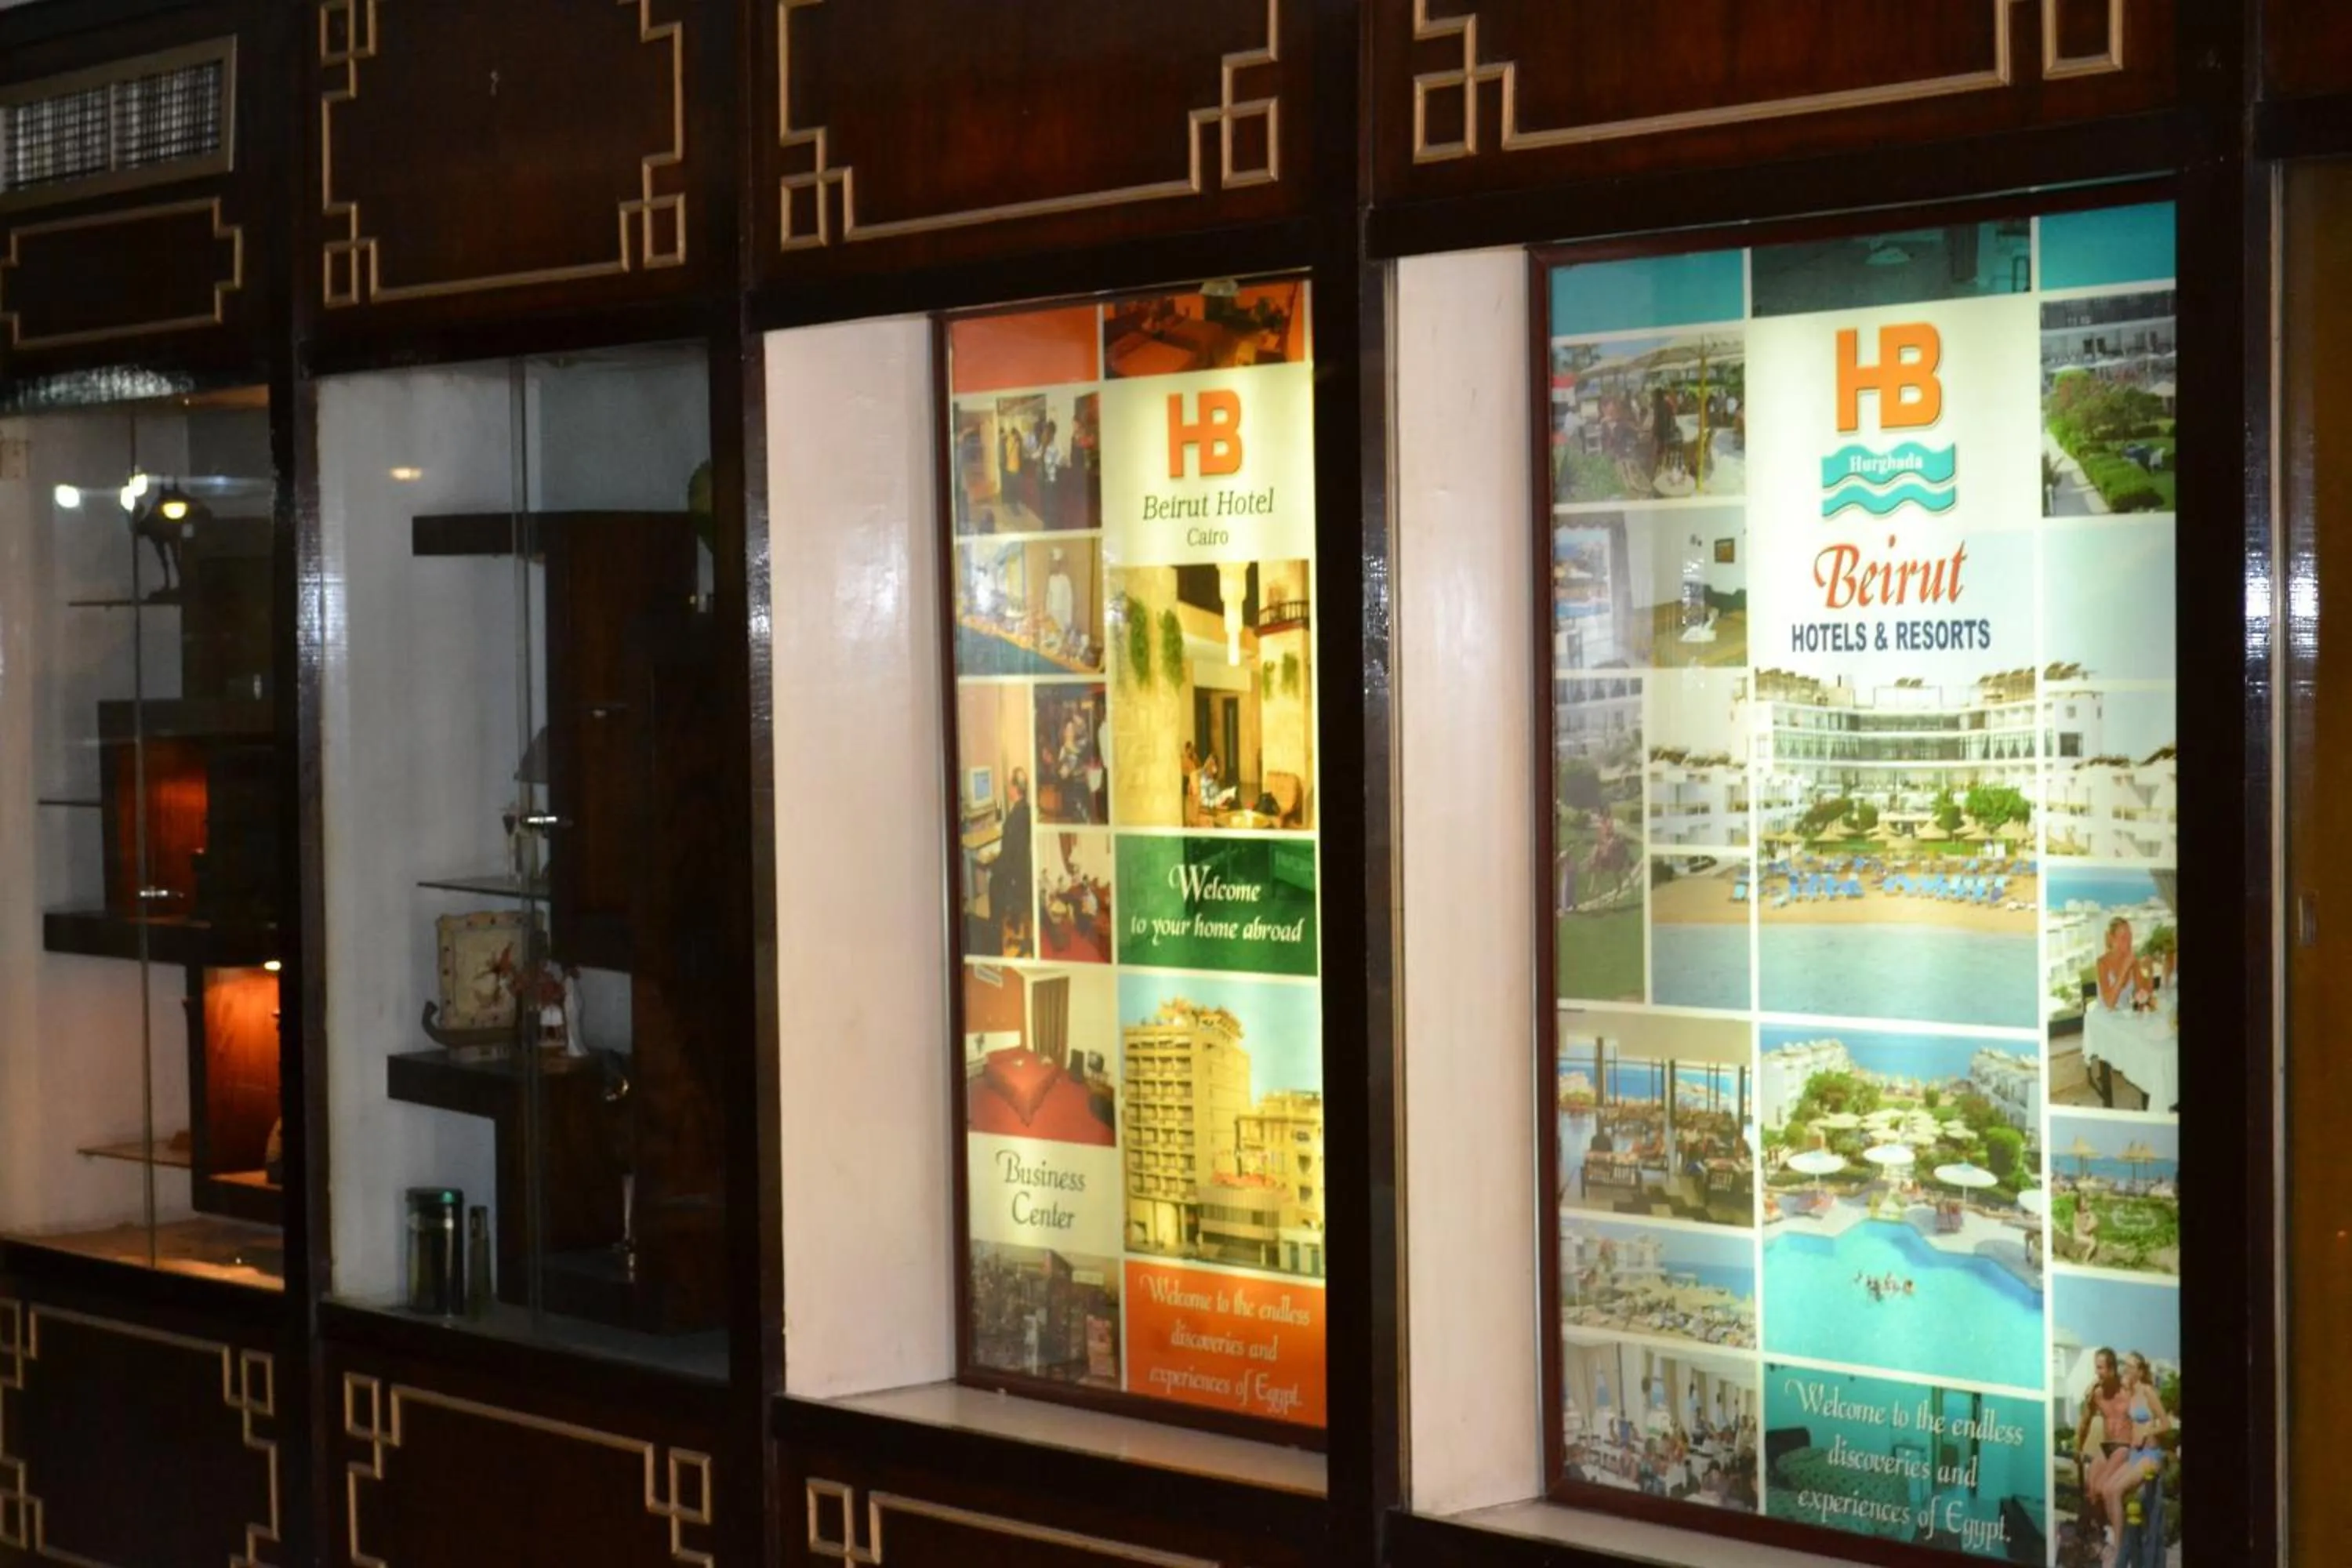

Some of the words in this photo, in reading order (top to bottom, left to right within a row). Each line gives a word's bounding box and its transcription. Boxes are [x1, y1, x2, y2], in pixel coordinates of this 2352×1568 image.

[1836, 322, 1943, 432] HB
[1167, 389, 1243, 479] HB
[1849, 454, 1924, 474] Hurghada
[1142, 494, 1209, 521] Beirut
[1216, 487, 1275, 517] Hotel
[1186, 528, 1229, 546] Cairo
[1813, 534, 1968, 609] Beirut
[1791, 622, 1867, 652] HOTELS
[1874, 621, 1889, 651] &
[1896, 619, 1991, 650] RESORTS
[1167, 863, 1261, 902] Welcome
[1131, 916, 1147, 935] to
[1151, 917, 1191, 946] your
[1194, 913, 1239, 939] home
[1243, 915, 1305, 942] abroad
[996, 1149, 1087, 1192] Business
[1011, 1191, 1076, 1231] Center
[1139, 1273, 1212, 1312] Welcome
[1216, 1291, 1229, 1313] to
[1233, 1290, 1256, 1318] the
[1259, 1294, 1311, 1327] endless
[1171, 1319, 1245, 1356] discoveries
[1249, 1334, 1279, 1363] and
[1149, 1366, 1231, 1395] experiences
[1236, 1367, 1252, 1406] of
[1254, 1374, 1304, 1416] Egypt.
[1784, 1378, 1886, 1425] Welcome
[1892, 1399, 1910, 1428] to
[1916, 1399, 1946, 1433] the
[1951, 1407, 2025, 1445] endless
[1827, 1434, 1931, 1479] discoveries
[1936, 1455, 1979, 1487] and
[1797, 1489, 1911, 1525] experiences
[1917, 1494, 1940, 1541] of
[1944, 1500, 2013, 1551] Egypt.
